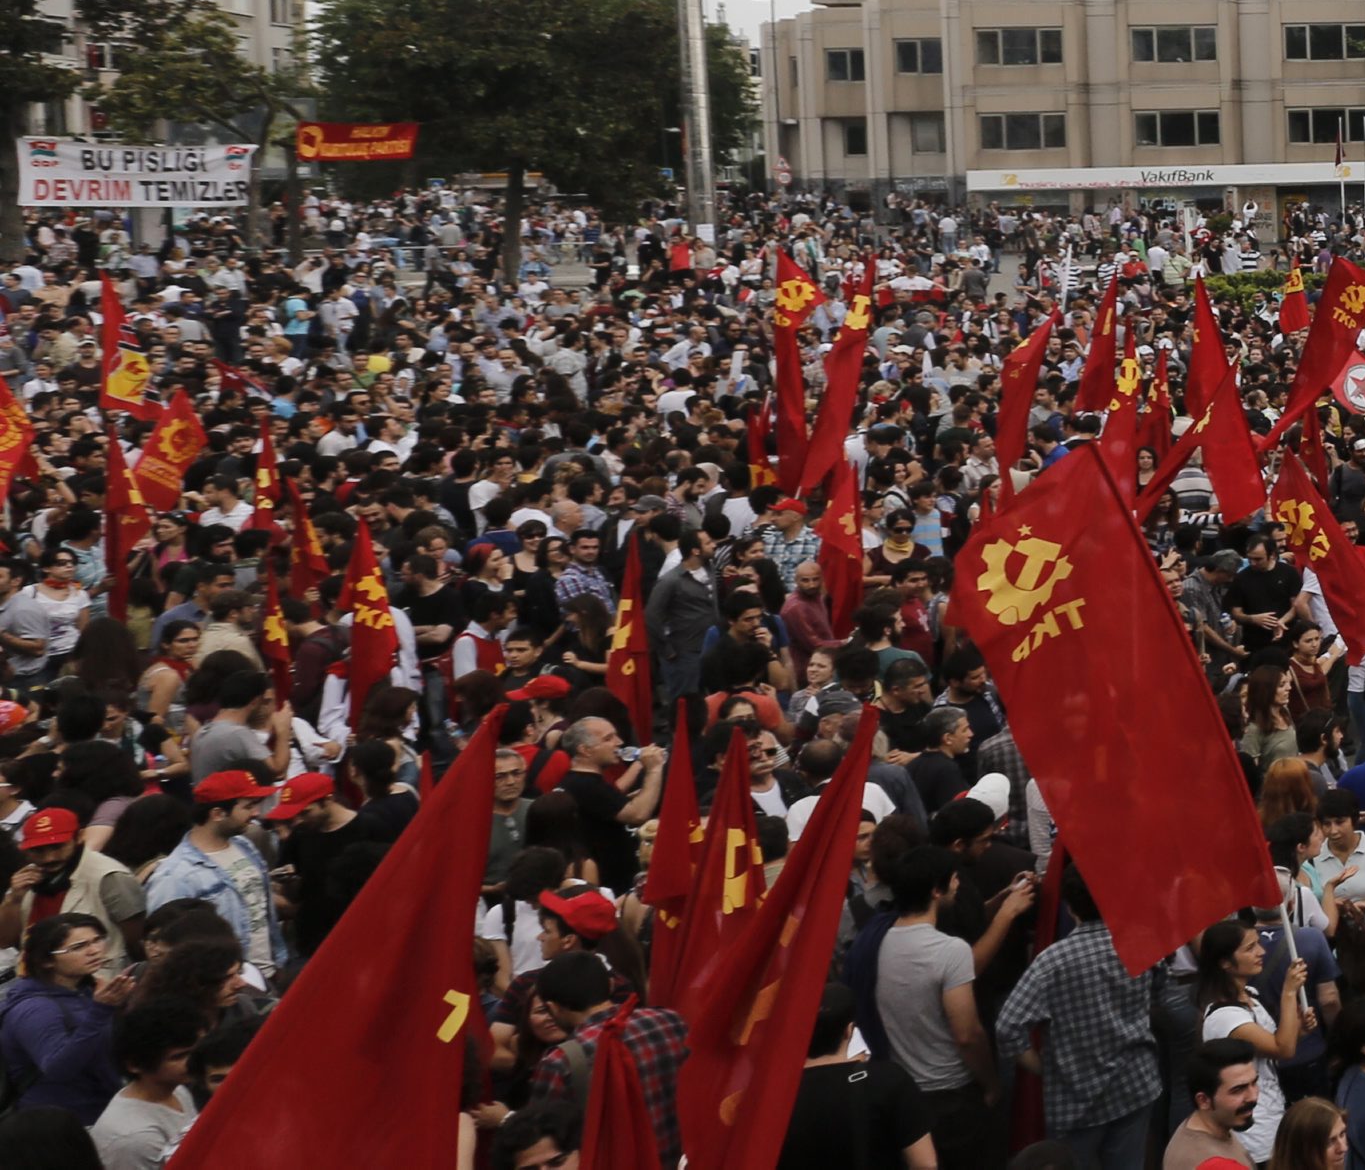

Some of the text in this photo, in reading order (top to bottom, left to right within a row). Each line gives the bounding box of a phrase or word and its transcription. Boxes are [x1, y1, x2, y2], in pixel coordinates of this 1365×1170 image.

[81, 150, 113, 172] BU
[122, 148, 207, 173] PİSLİĞİ
[33, 176, 248, 204] DEVRİM TEMİZLER
[1333, 306, 1357, 329] TKP
